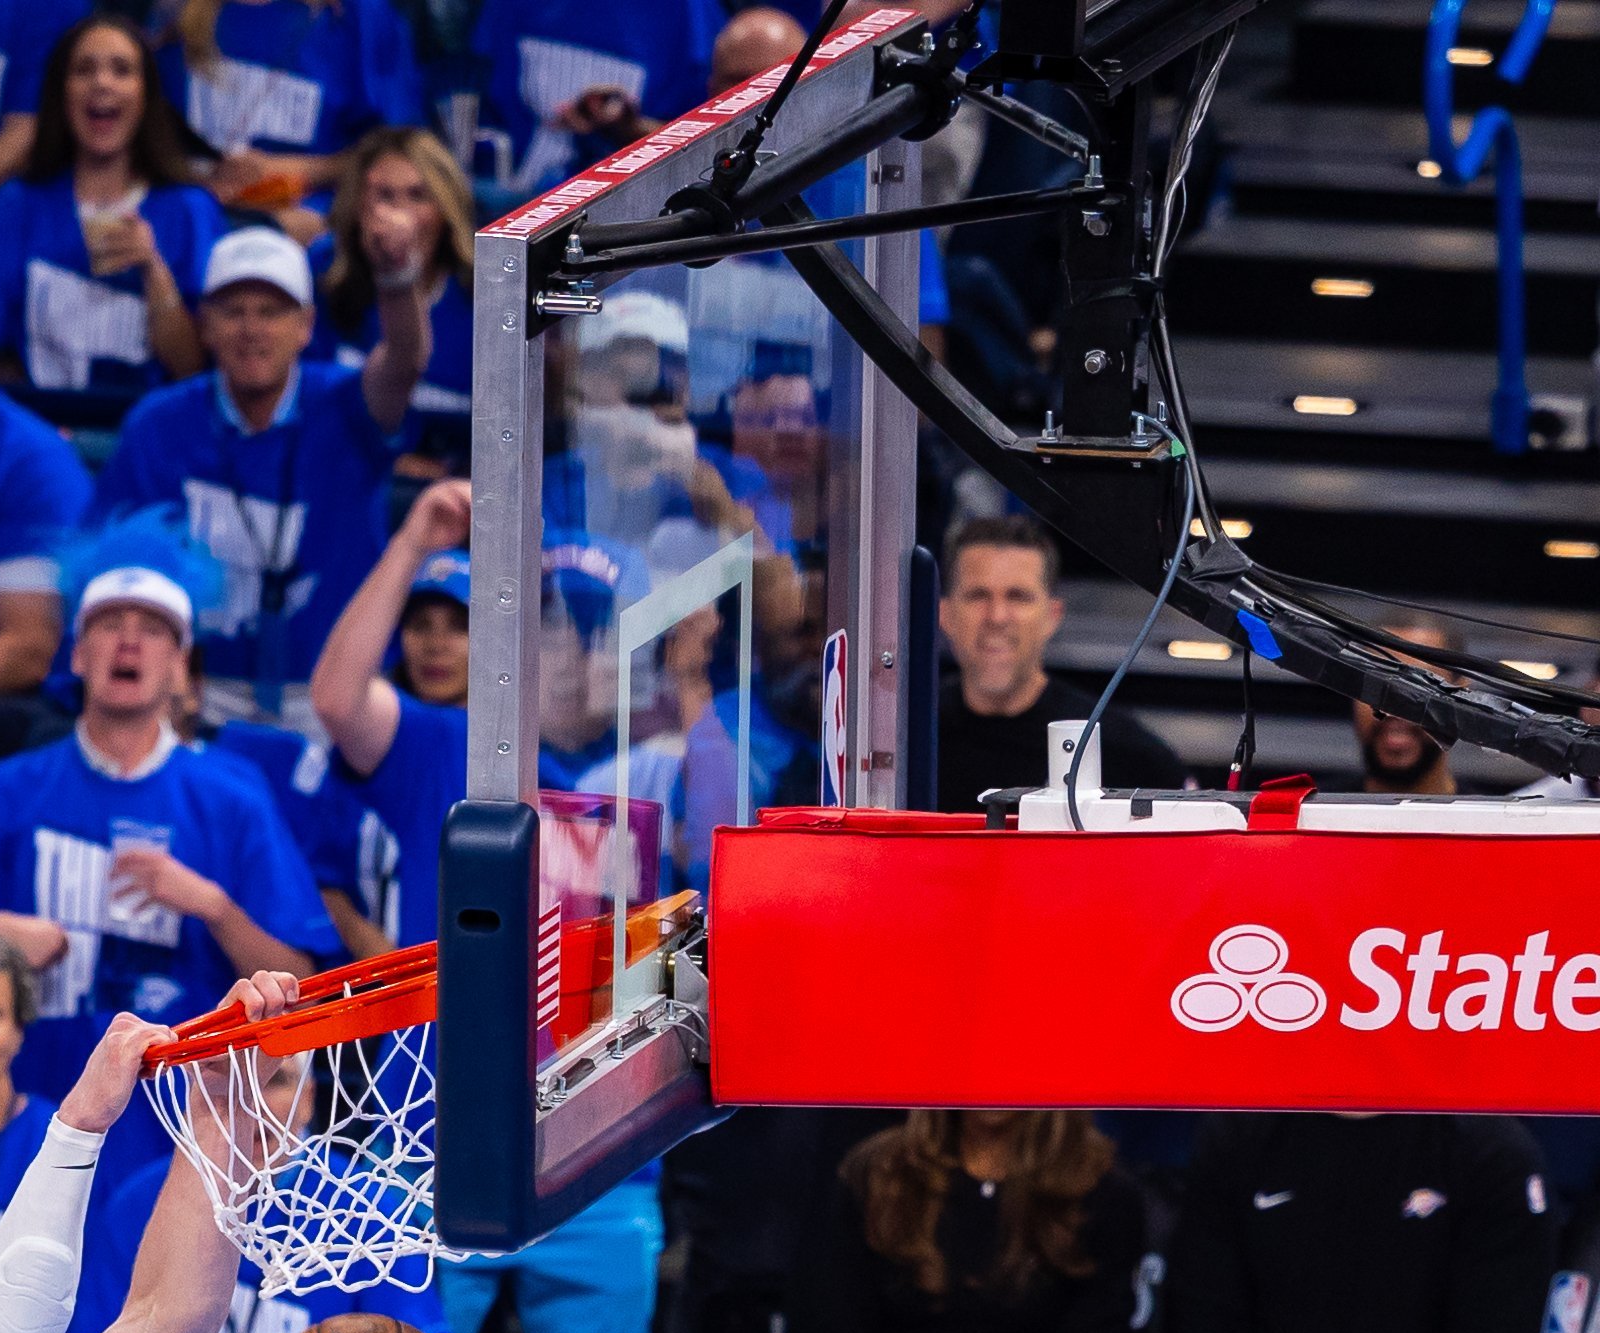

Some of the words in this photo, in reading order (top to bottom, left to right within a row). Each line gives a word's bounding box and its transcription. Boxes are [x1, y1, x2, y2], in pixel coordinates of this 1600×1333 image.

[698, 85, 777, 115] Emirates
[594, 143, 674, 174] Emirates
[488, 203, 571, 235] Emirates
[1339, 925, 1600, 1033] State
